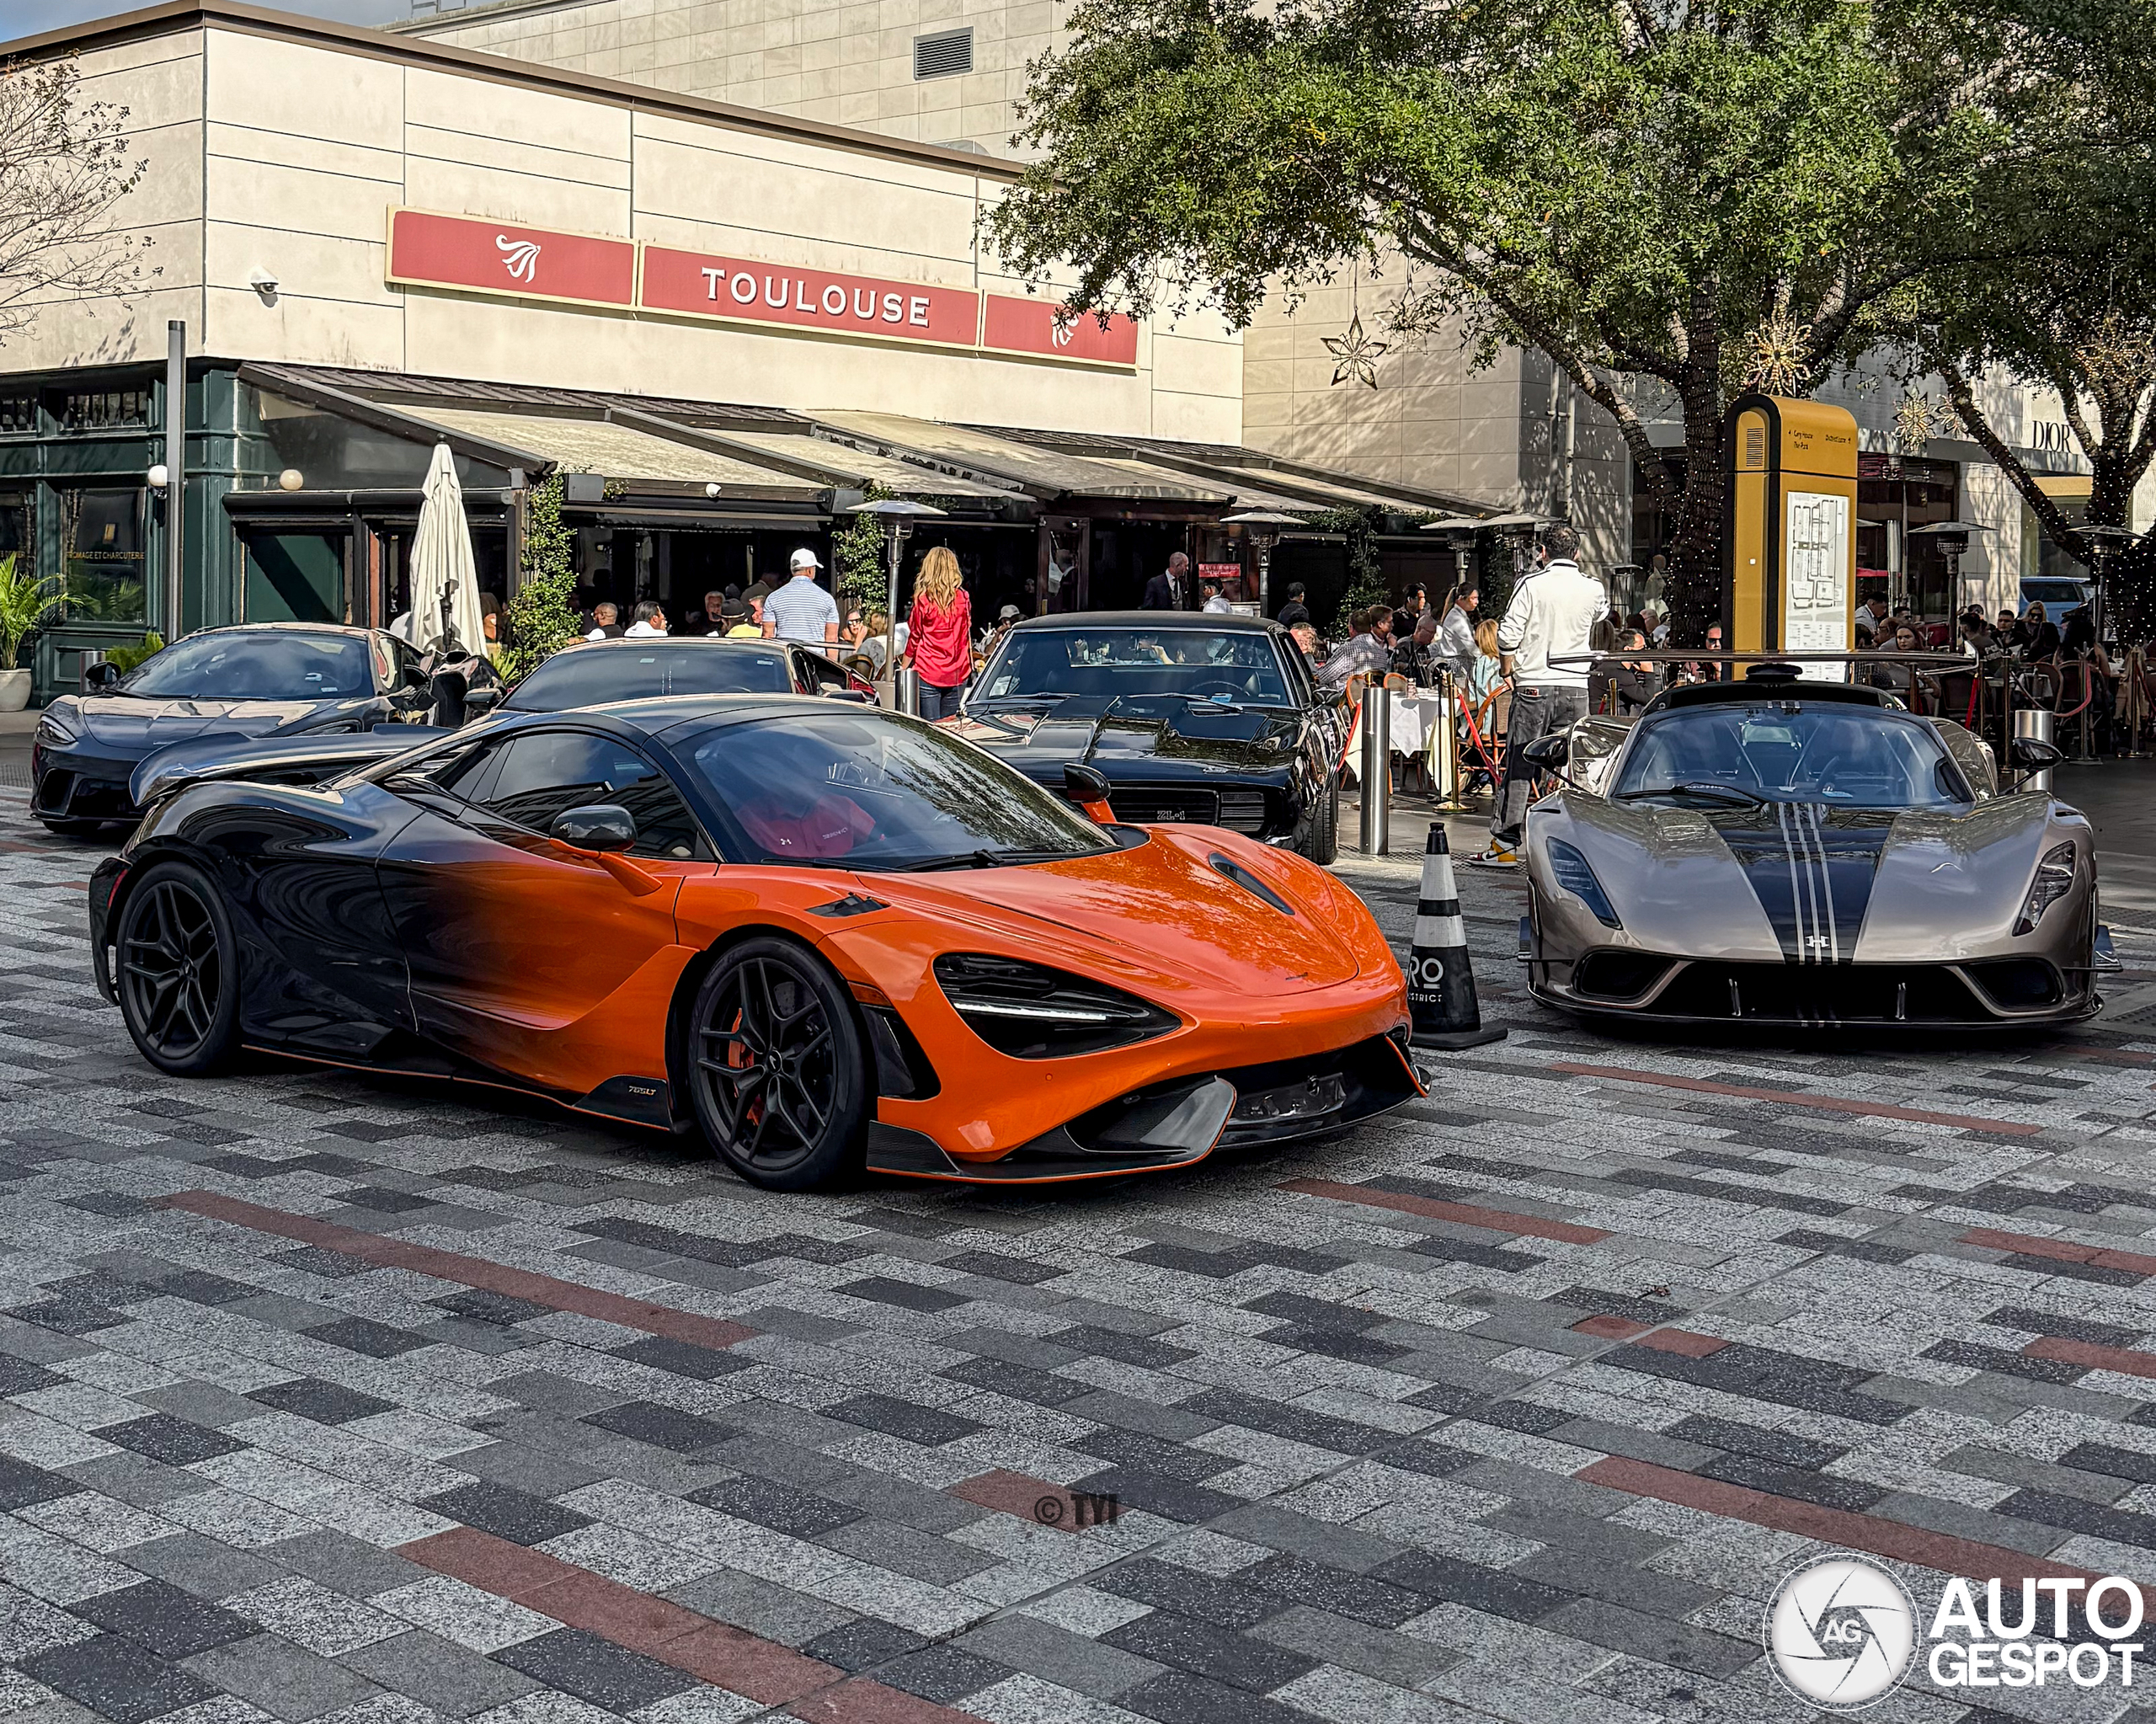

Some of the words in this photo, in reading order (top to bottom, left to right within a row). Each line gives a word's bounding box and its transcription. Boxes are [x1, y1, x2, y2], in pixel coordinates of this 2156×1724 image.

[702, 266, 930, 328] TOULOUSE
[2032, 420, 2073, 454] DIOR
[102, 552, 145, 560] CHARCUTERIE
